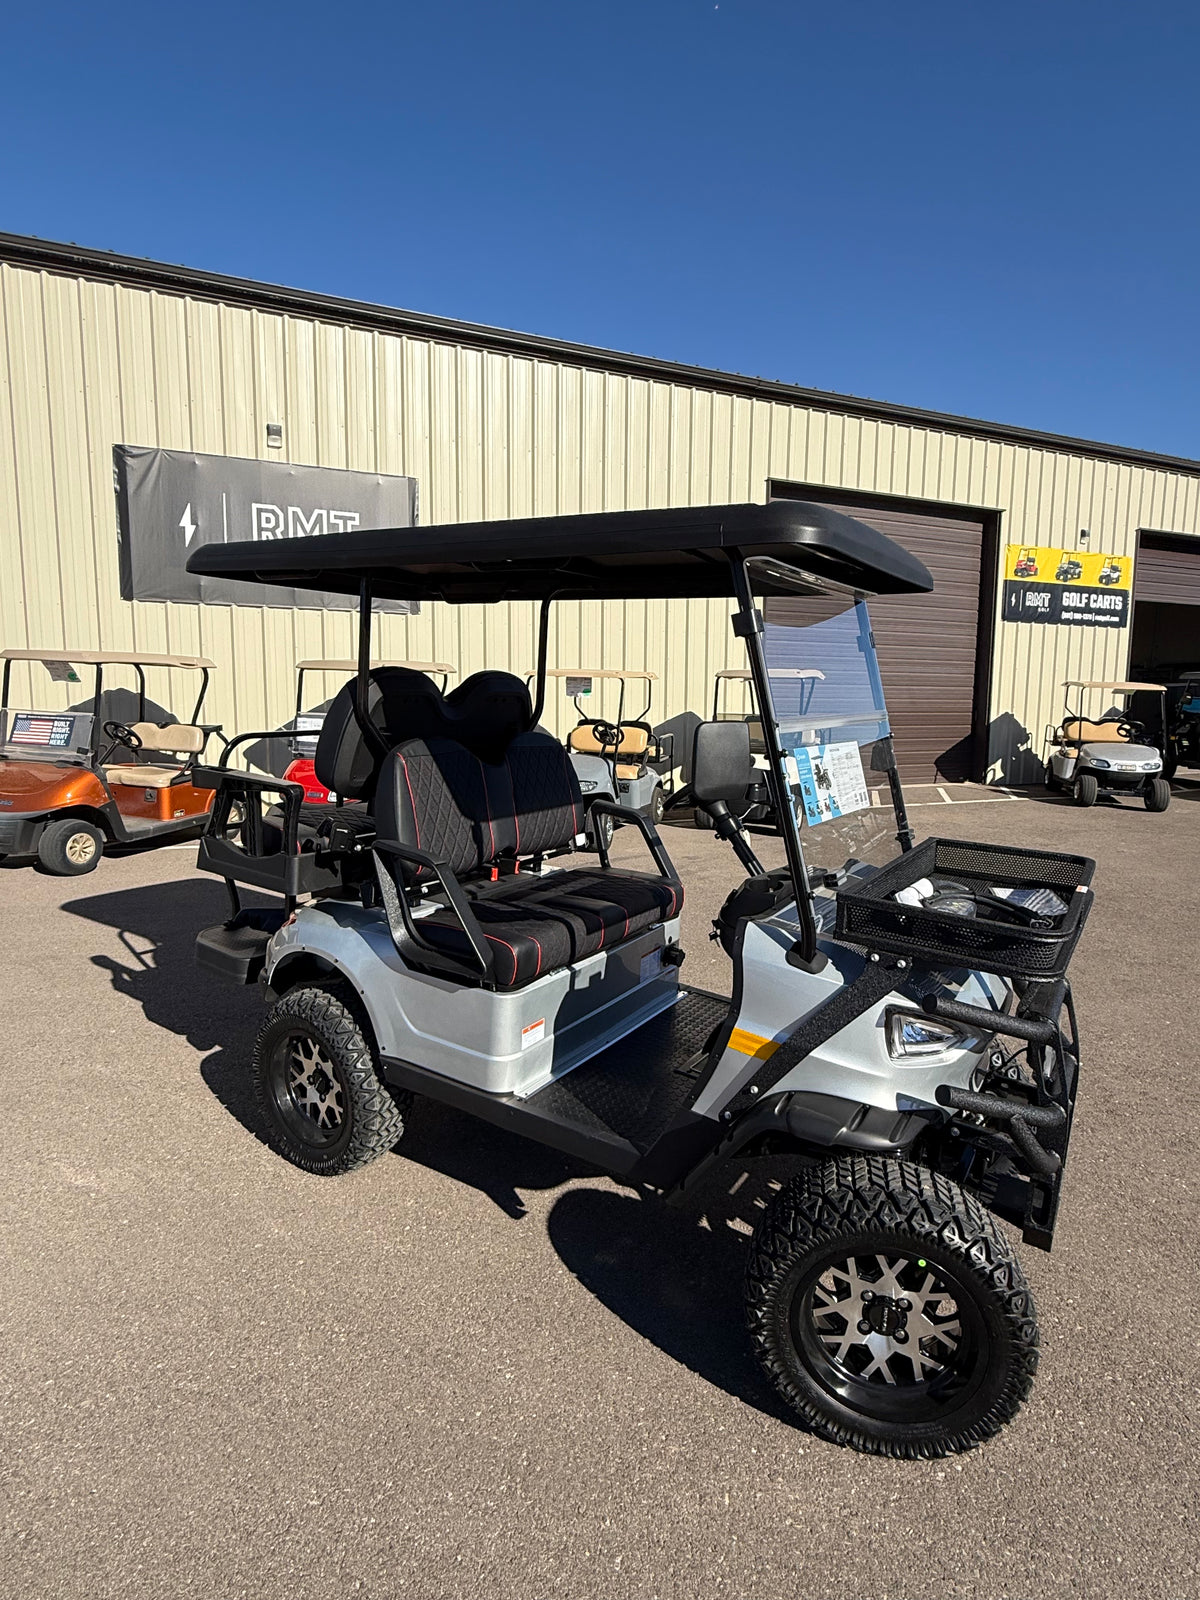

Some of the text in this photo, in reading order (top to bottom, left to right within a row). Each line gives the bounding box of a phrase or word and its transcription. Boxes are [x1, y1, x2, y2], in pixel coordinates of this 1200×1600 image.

[251, 502, 360, 541] RMT
[1026, 592, 1051, 607] RMT
[1062, 592, 1123, 610] GOLF CARTS
